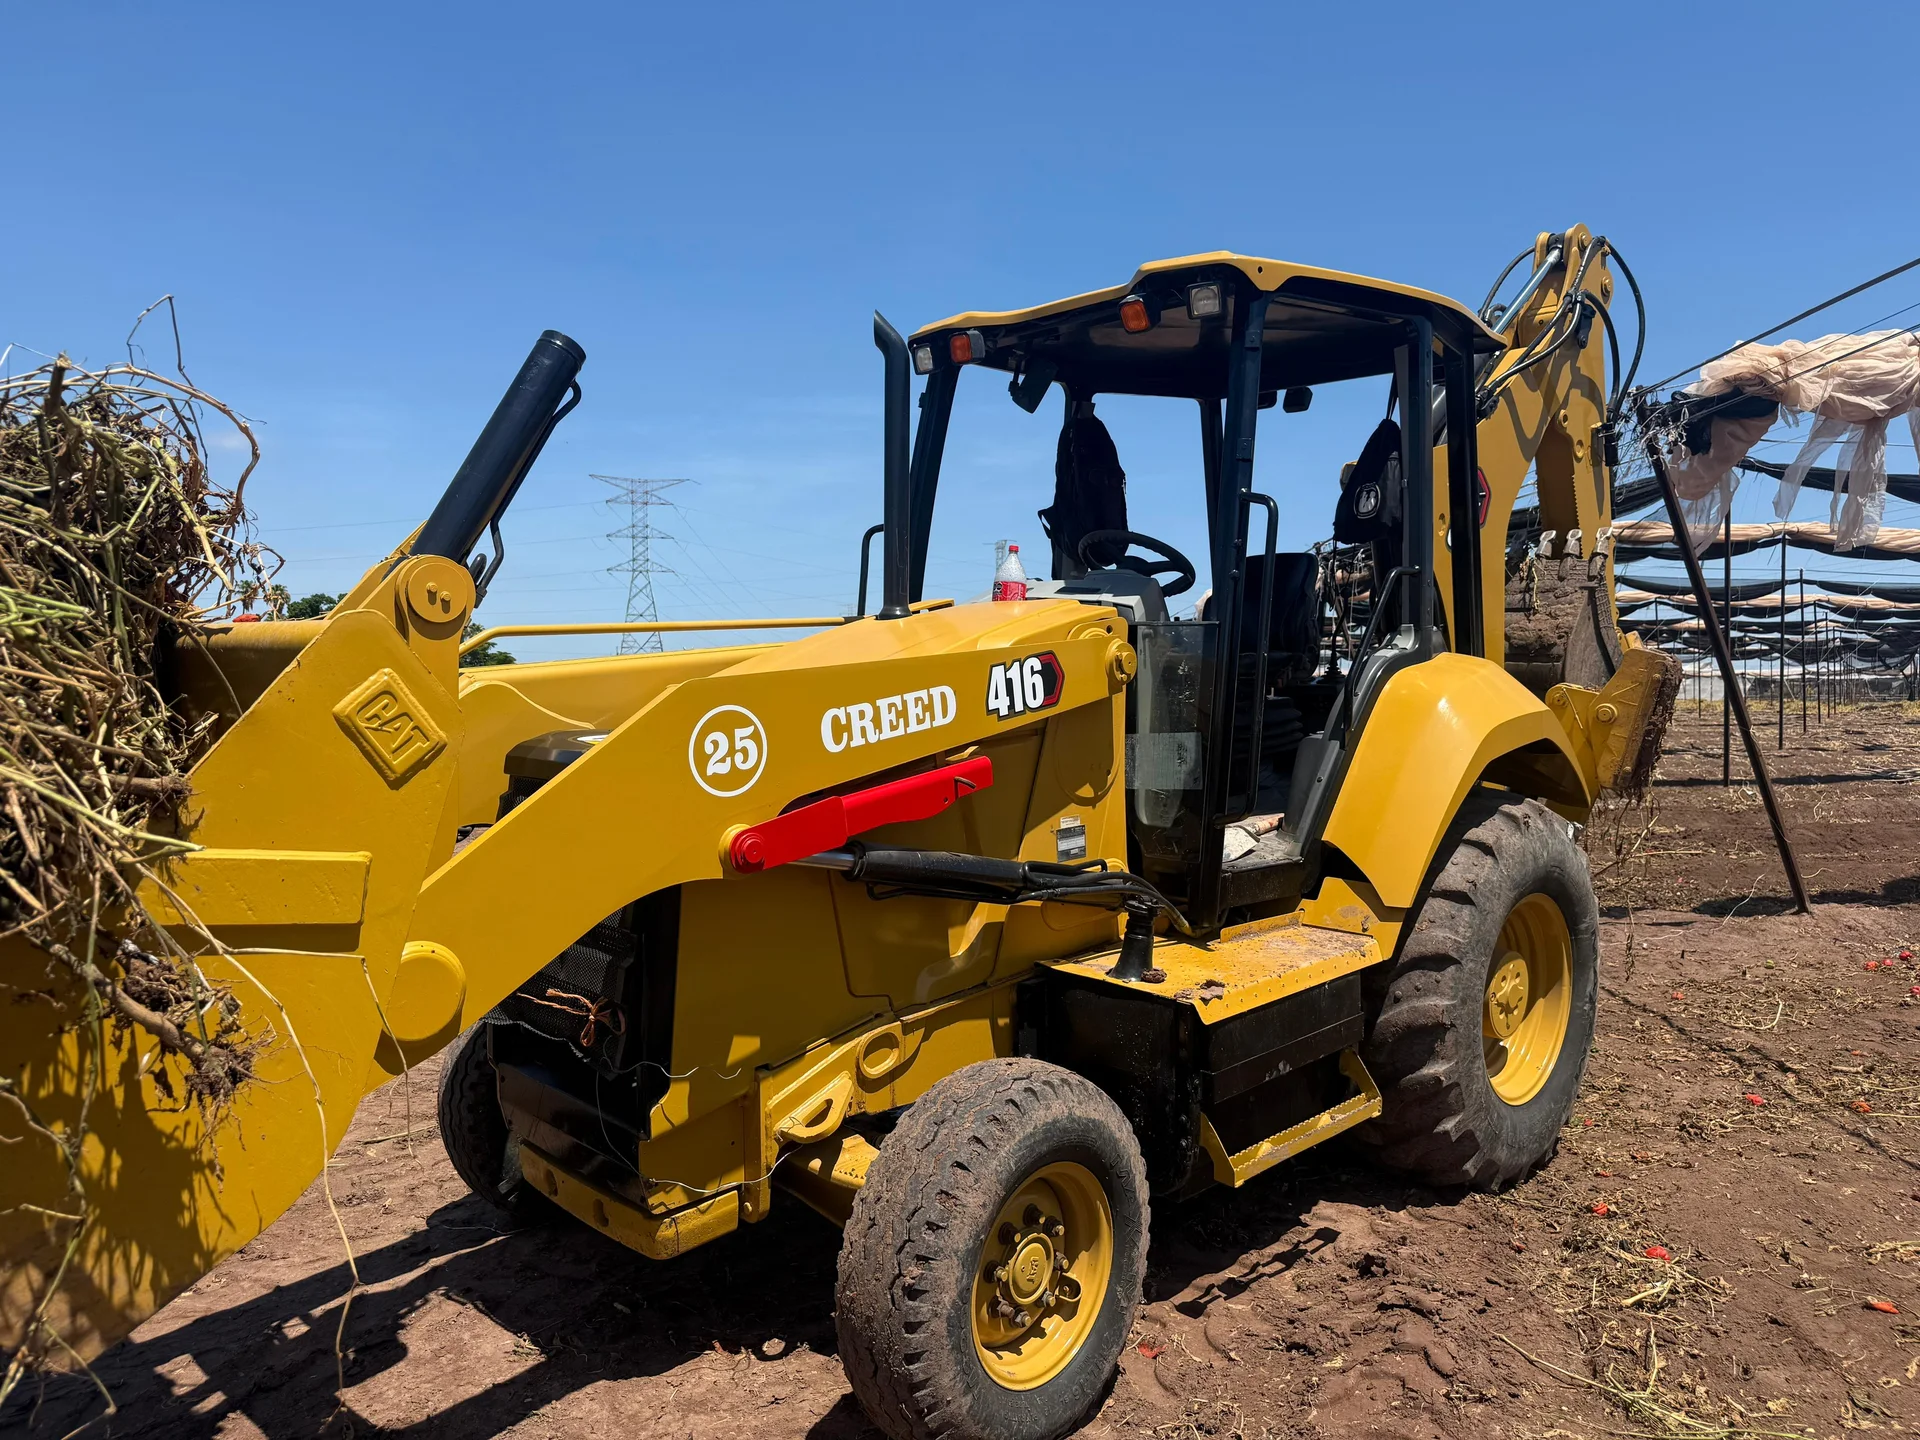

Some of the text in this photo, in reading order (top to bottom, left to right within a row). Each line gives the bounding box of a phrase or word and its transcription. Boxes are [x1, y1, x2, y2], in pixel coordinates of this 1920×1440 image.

[987, 656, 1045, 717] 416
[356, 690, 430, 764] CAT
[704, 725, 758, 776] 25
[820, 685, 957, 753] CREED
